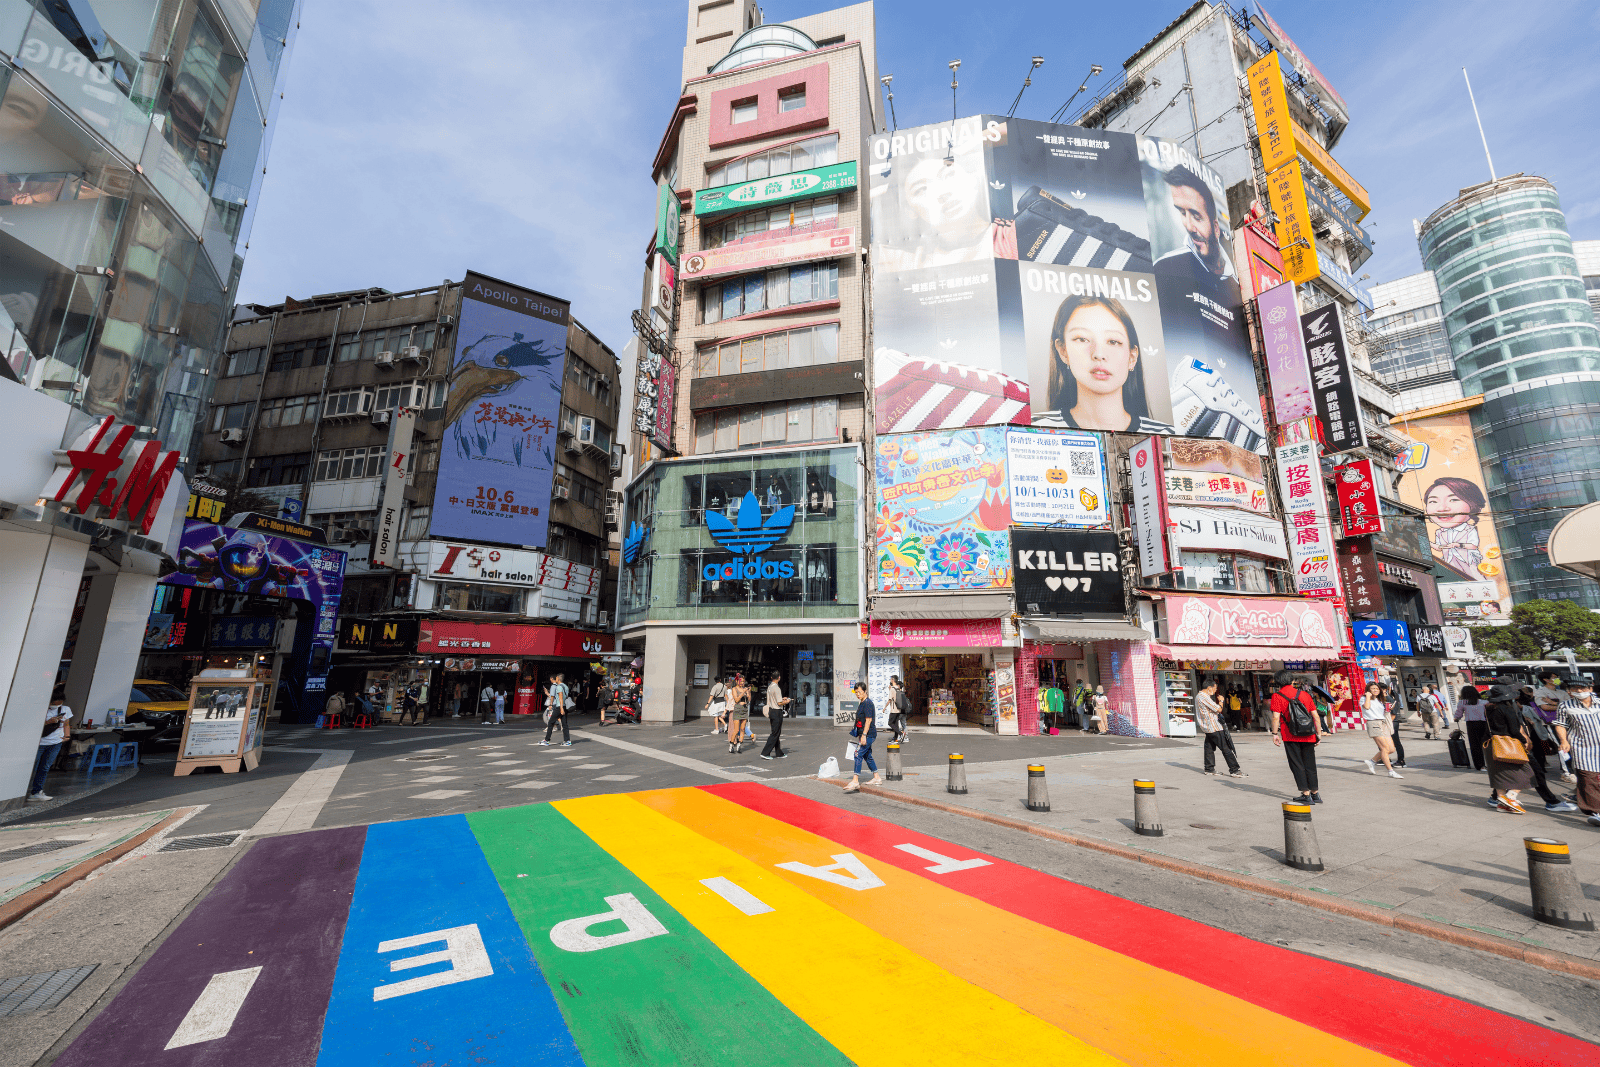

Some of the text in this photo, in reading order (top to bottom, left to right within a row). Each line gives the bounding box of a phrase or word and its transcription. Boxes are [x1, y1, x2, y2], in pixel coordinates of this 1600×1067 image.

[874, 120, 1001, 160] ORIGINALS
[1143, 139, 1223, 195] ORIGINALS
[1027, 229, 1049, 259] SUPERSTAR
[473, 283, 563, 318] Apollo Taipei
[1027, 269, 1152, 303] ORIGINALS
[1273, 326, 1293, 372] 湯の花
[1310, 342, 1341, 390] 駭客
[637, 358, 657, 432] 我就厲害
[881, 395, 914, 429] GAZELLE
[1180, 405, 1200, 429] SAMBA
[1326, 391, 1345, 442] 網路電競館
[1280, 444, 1310, 459] 玉芙蓉
[55, 414, 181, 535] H&M
[882, 462, 996, 501] 西門町青春文化季
[1207, 477, 1232, 492] 按摩
[1286, 464, 1312, 499] 按摩
[449, 496, 539, 516] 中、日文版 震撼登場
[475, 486, 515, 504] 10.6
[1014, 486, 1075, 499] 10/1~10/31
[471, 508, 494, 517] IMAX
[1293, 509, 1319, 545] 護膚
[286, 524, 313, 538] Walker
[379, 507, 396, 555] hair salon
[1213, 520, 1249, 538] Hair
[1249, 525, 1277, 545] Salon
[481, 568, 533, 582] hair salon
[703, 556, 795, 581] adidas
[1018, 550, 1118, 572] KILLER
[1300, 557, 1329, 575] 699
[1358, 639, 1393, 652] 久大文具
